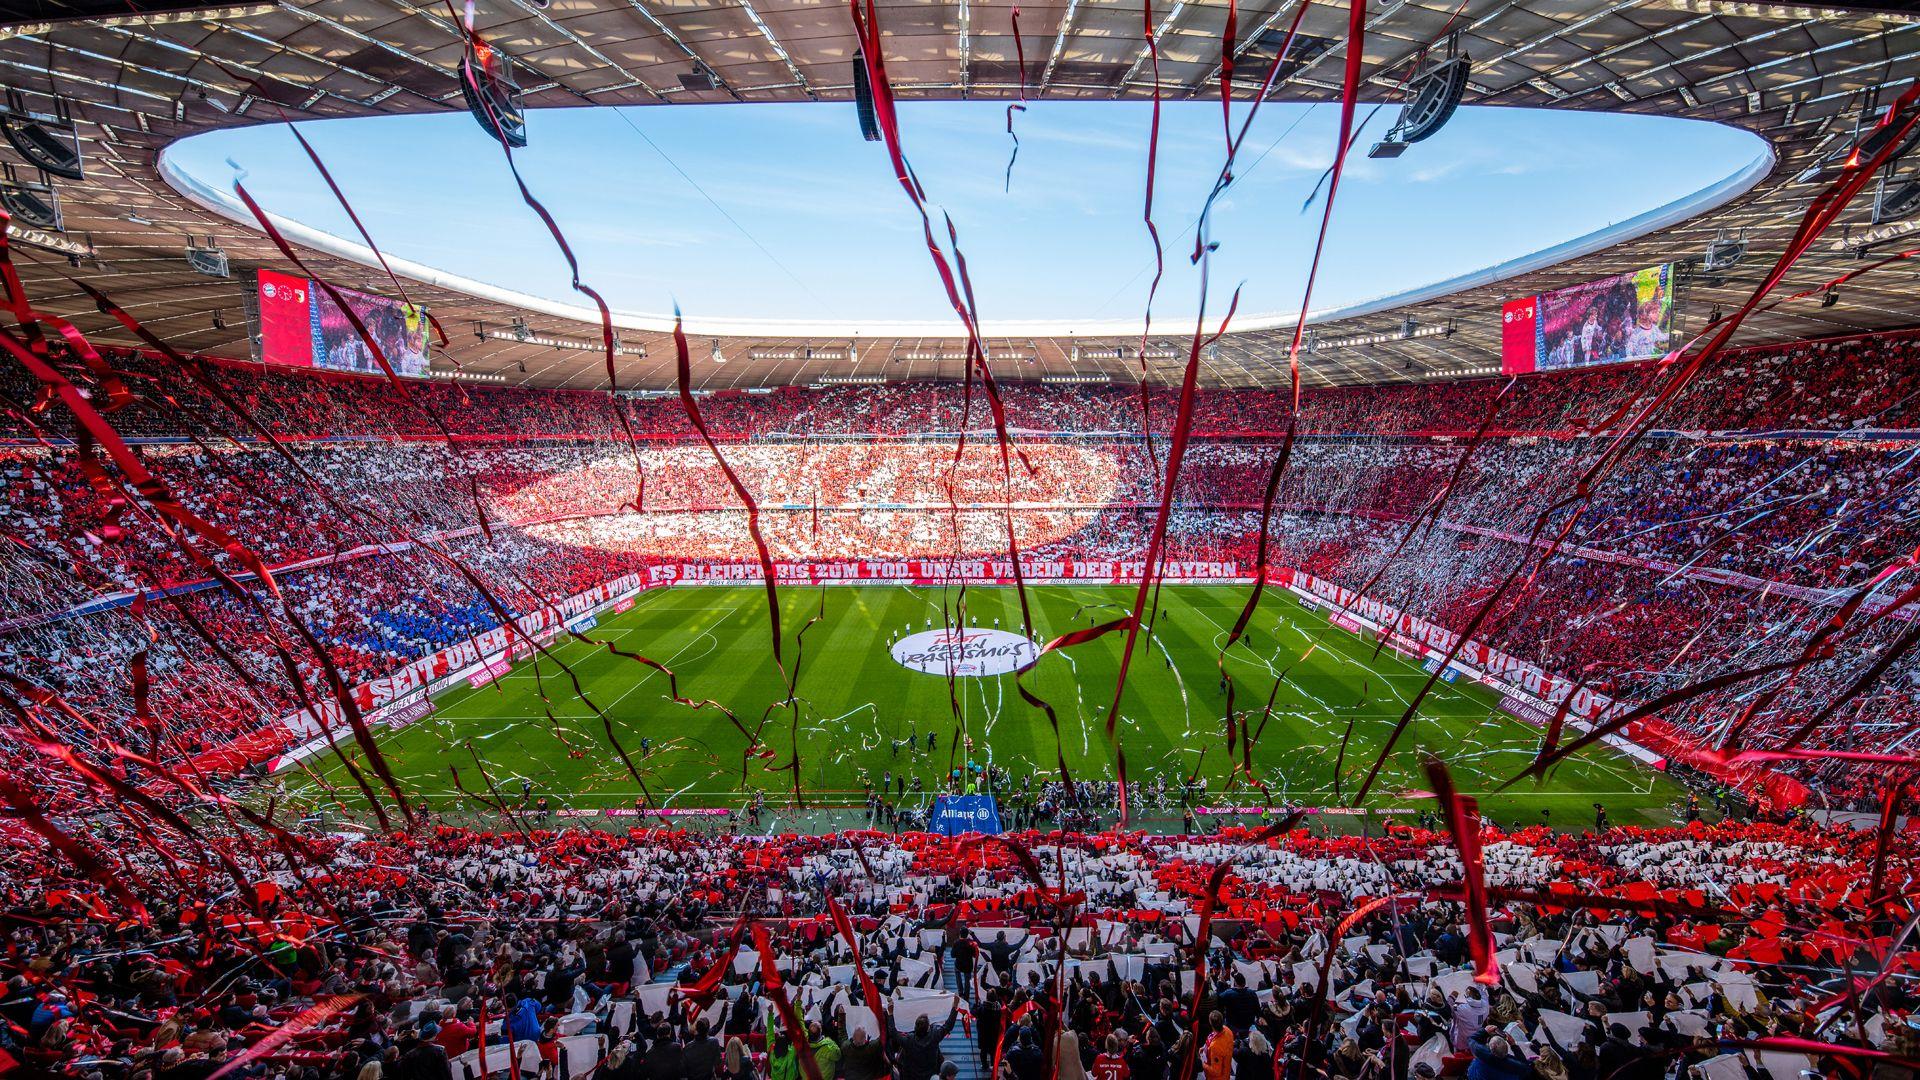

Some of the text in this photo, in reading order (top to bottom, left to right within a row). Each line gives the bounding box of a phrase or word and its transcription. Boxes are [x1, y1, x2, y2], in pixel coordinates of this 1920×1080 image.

[650, 564, 677, 581] ES
[775, 563, 810, 578] BIS
[815, 562, 859, 578] ZUM
[866, 562, 914, 578] TOD.
[921, 562, 985, 578] UNSER
[991, 562, 1065, 578] VEREIN
[1073, 562, 1112, 577] DER
[1121, 562, 1146, 577] FC
[1311, 575, 1338, 601] DEN
[369, 657, 439, 707] SEIT
[940, 809, 975, 819] Allianz
